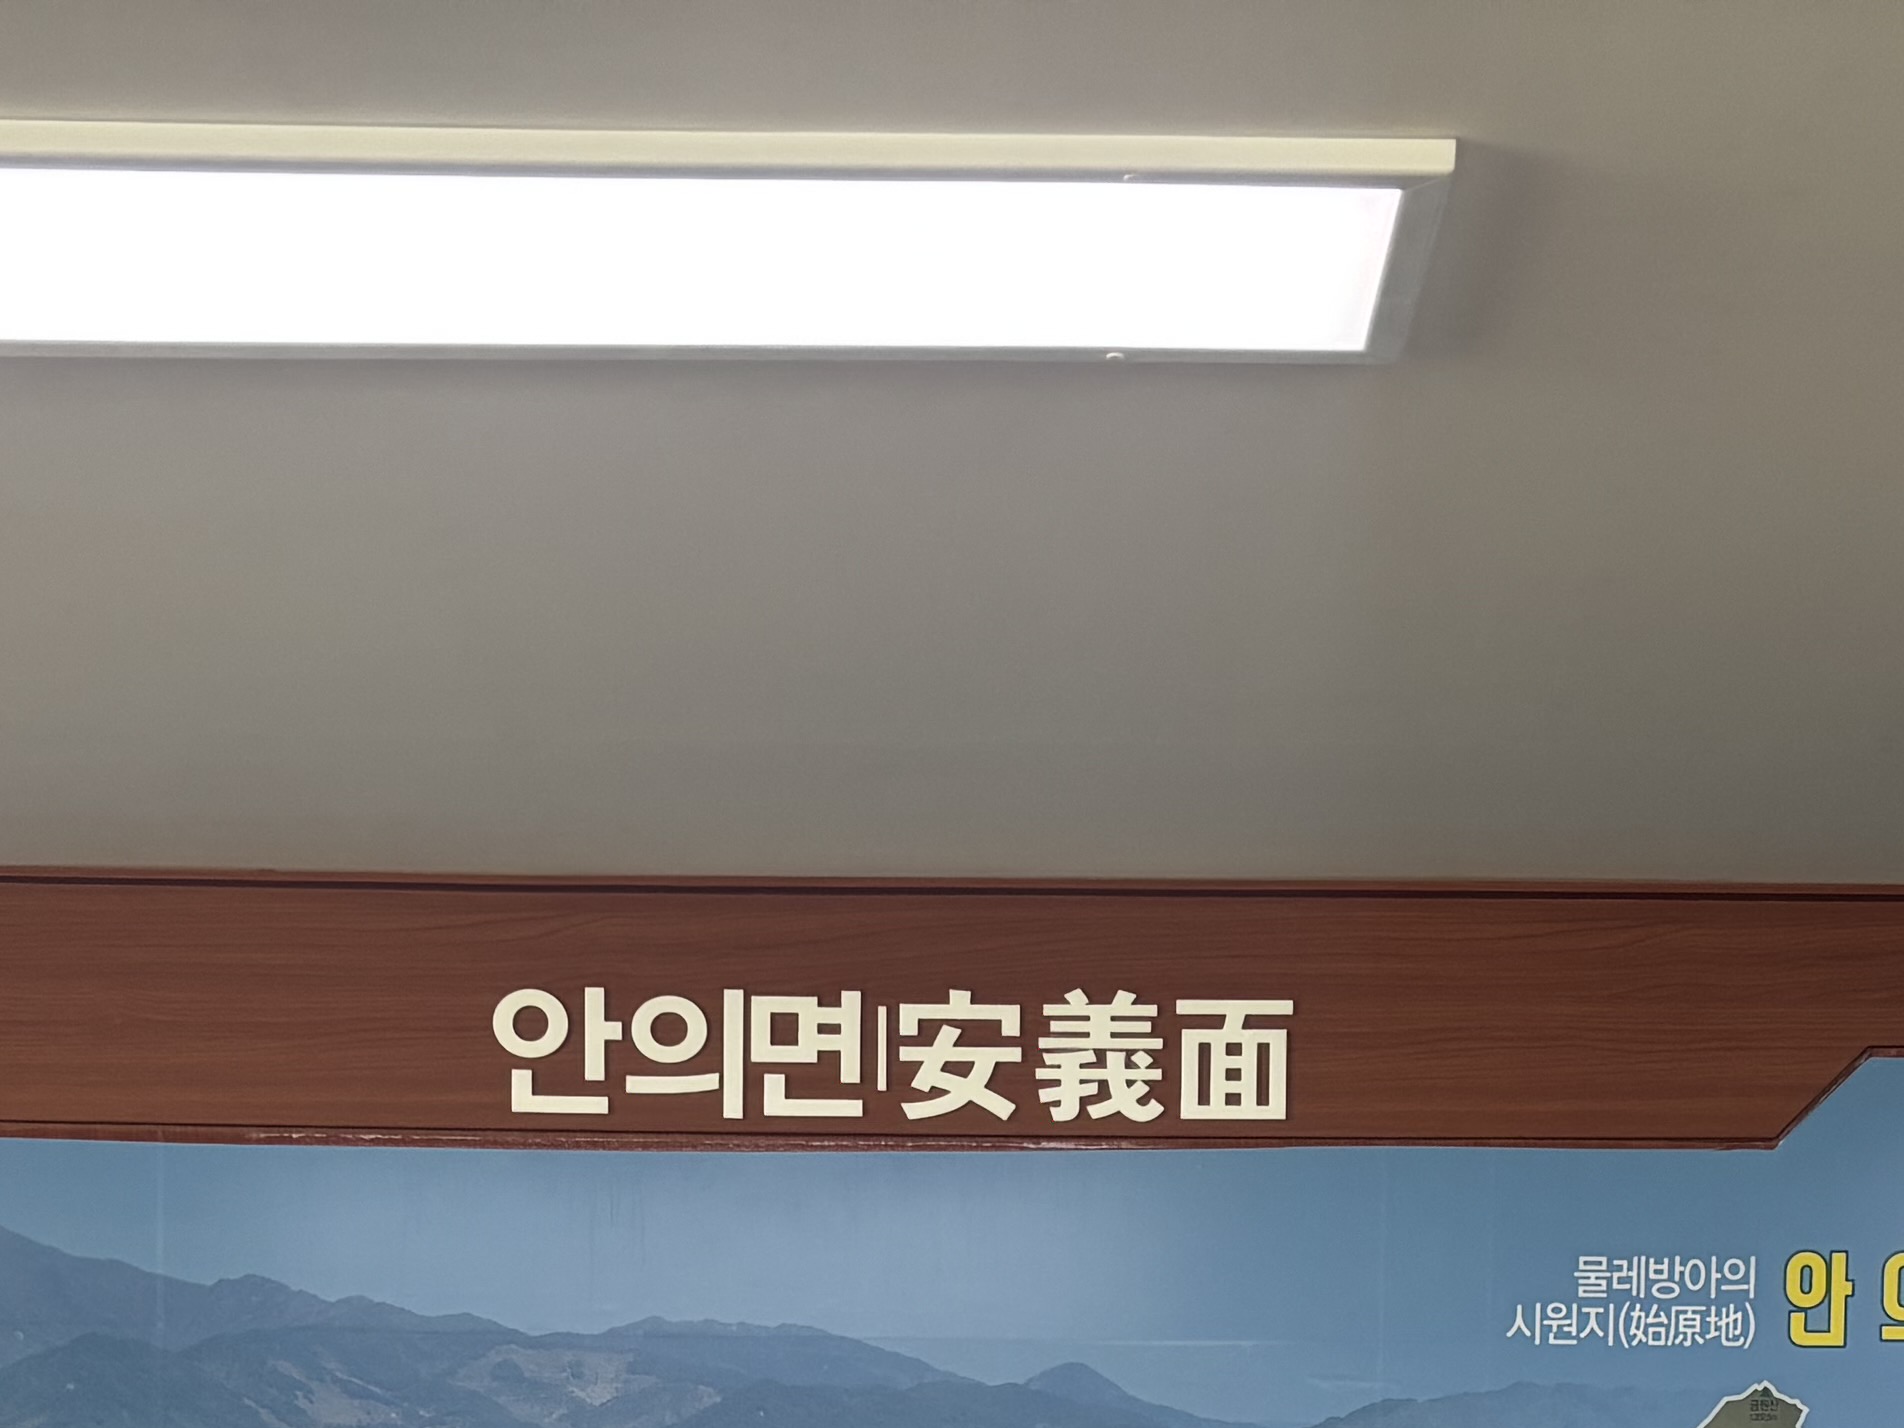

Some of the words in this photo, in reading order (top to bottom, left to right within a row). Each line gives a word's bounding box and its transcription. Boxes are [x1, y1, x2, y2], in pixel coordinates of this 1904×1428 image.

[493, 987, 863, 1119] 안의면
[899, 988, 1293, 1122] 安義面
[1574, 1256, 1755, 1299] 물레방아의
